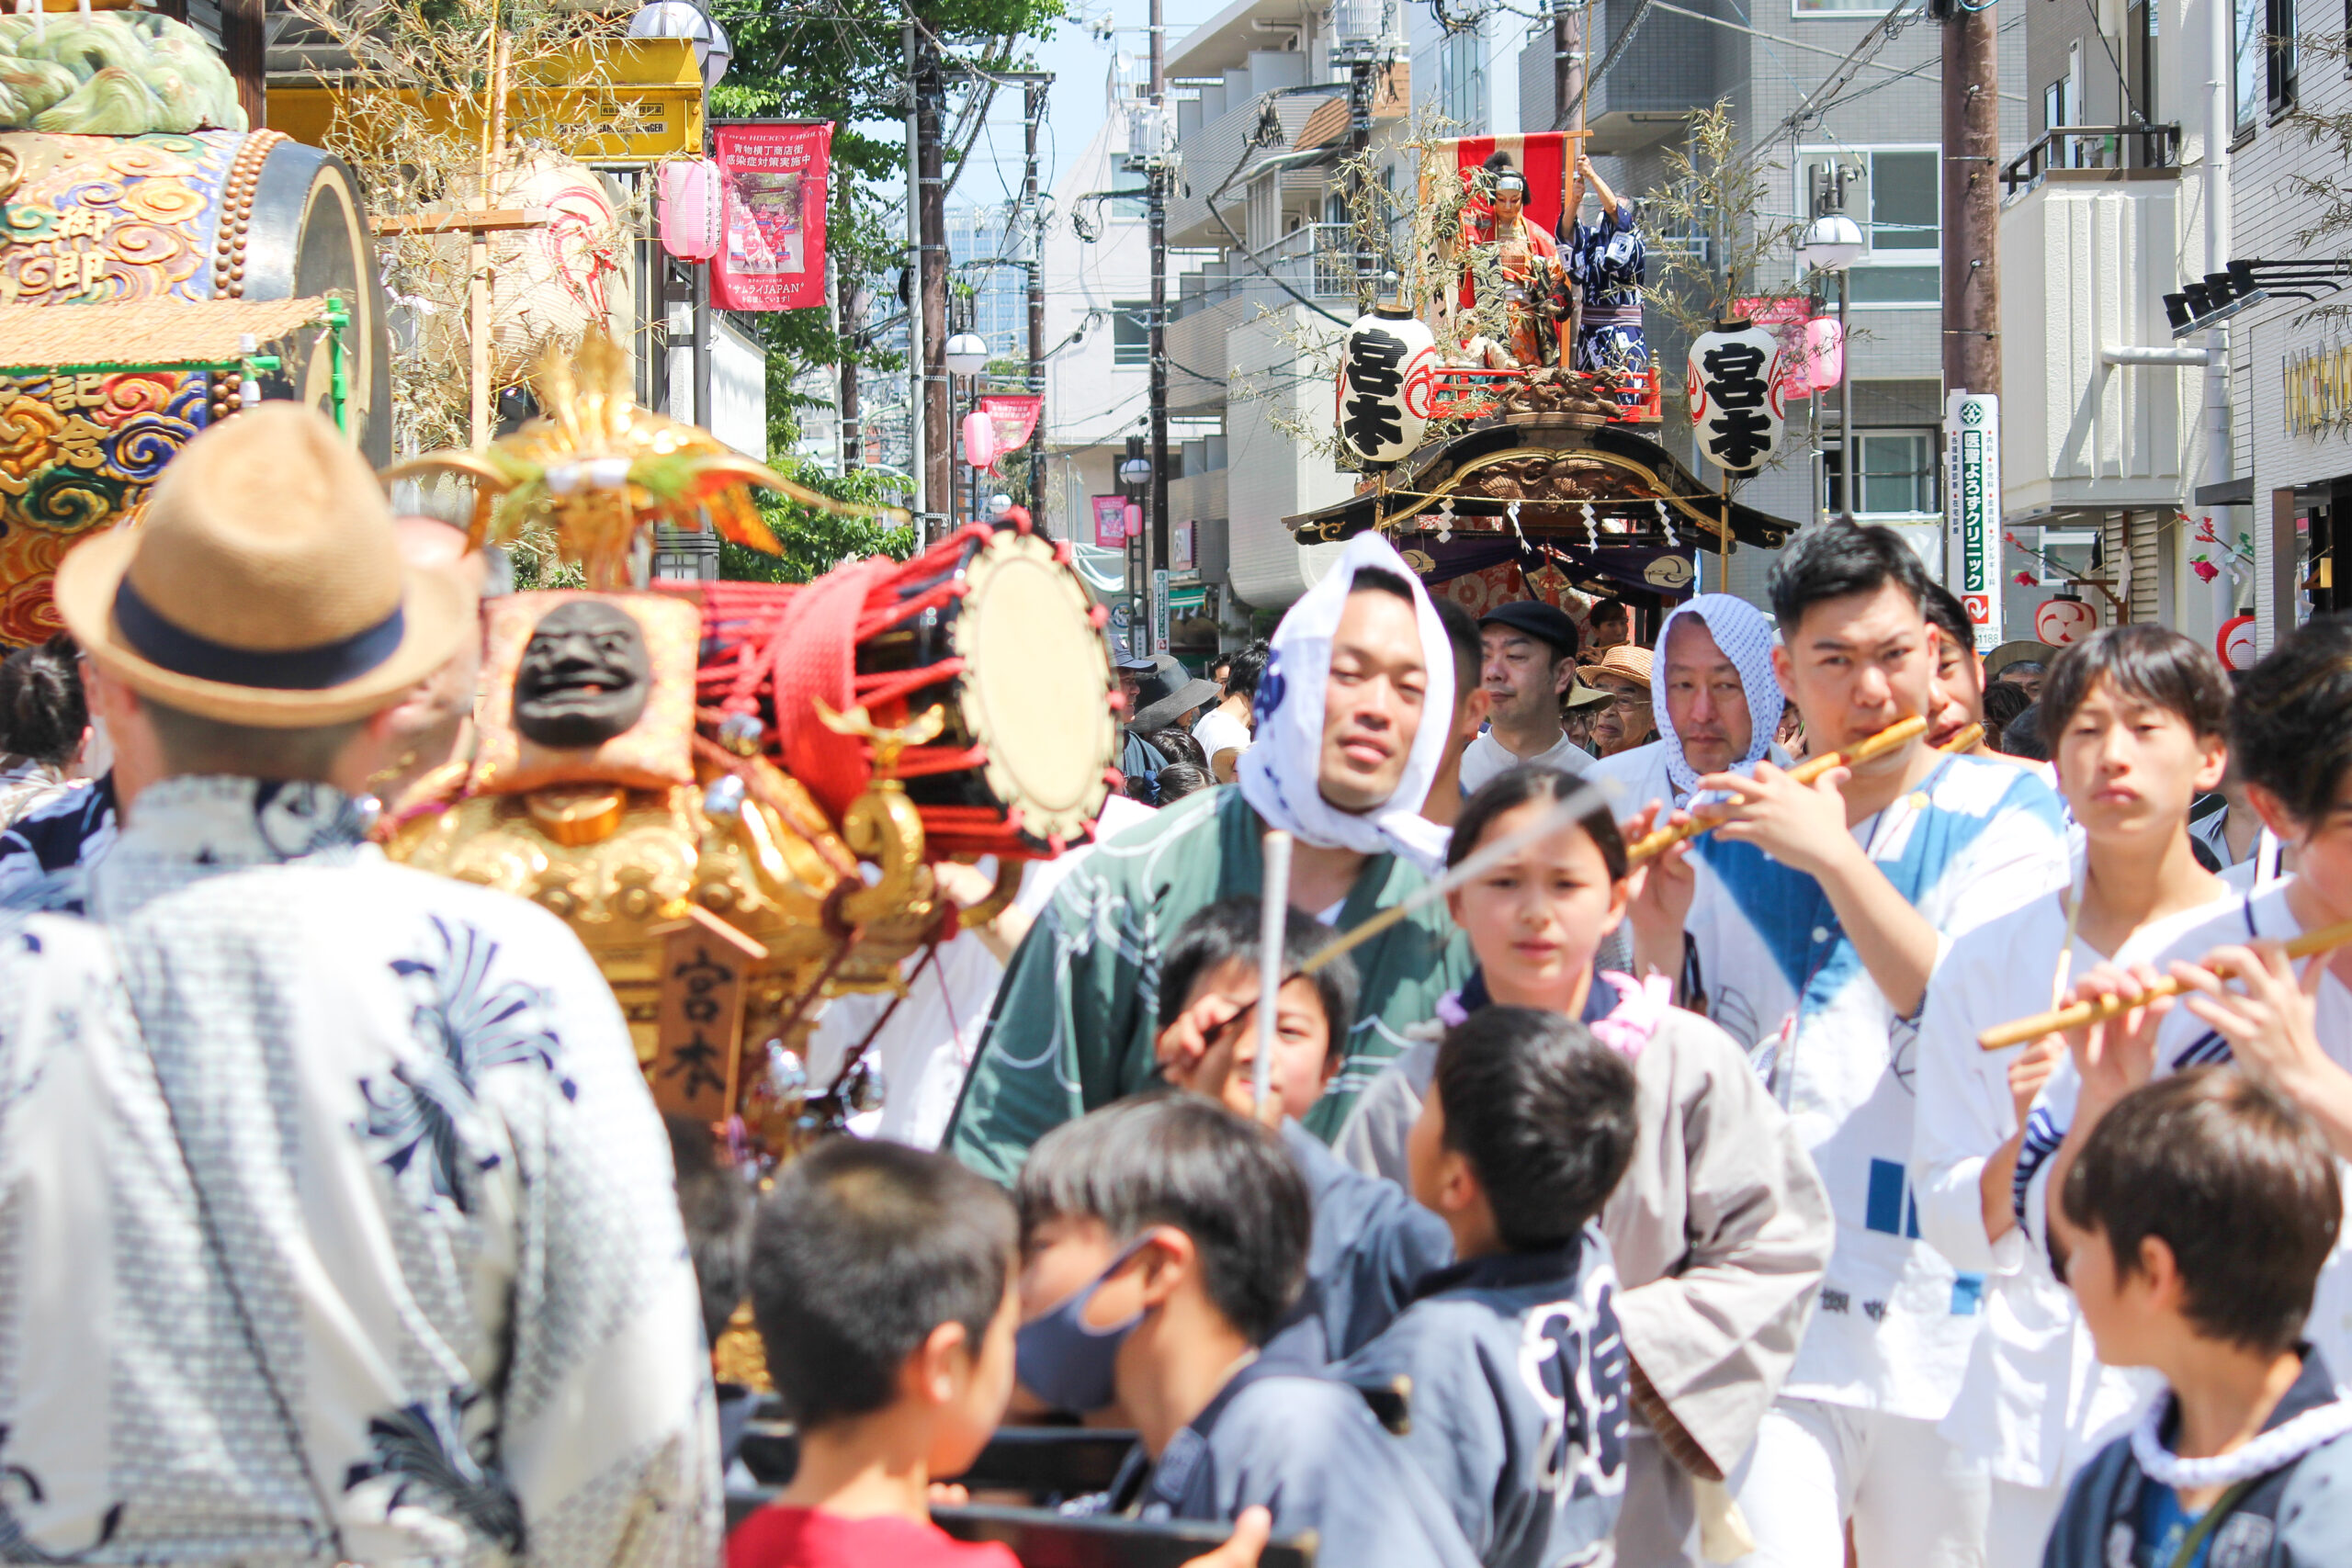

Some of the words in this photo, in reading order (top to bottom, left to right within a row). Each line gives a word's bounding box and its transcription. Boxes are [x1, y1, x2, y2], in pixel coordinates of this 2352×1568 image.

[726, 153, 811, 168] 感染症対策実施中
[733, 143, 804, 156] 青物横丁商店街
[731, 282, 800, 295] サムライJAPAN
[1344, 328, 1408, 457] 宮本
[1702, 343, 1772, 468] 宮本
[1963, 432, 1983, 590] 医聖よろずクリニック
[662, 944, 734, 1100] 宮本
